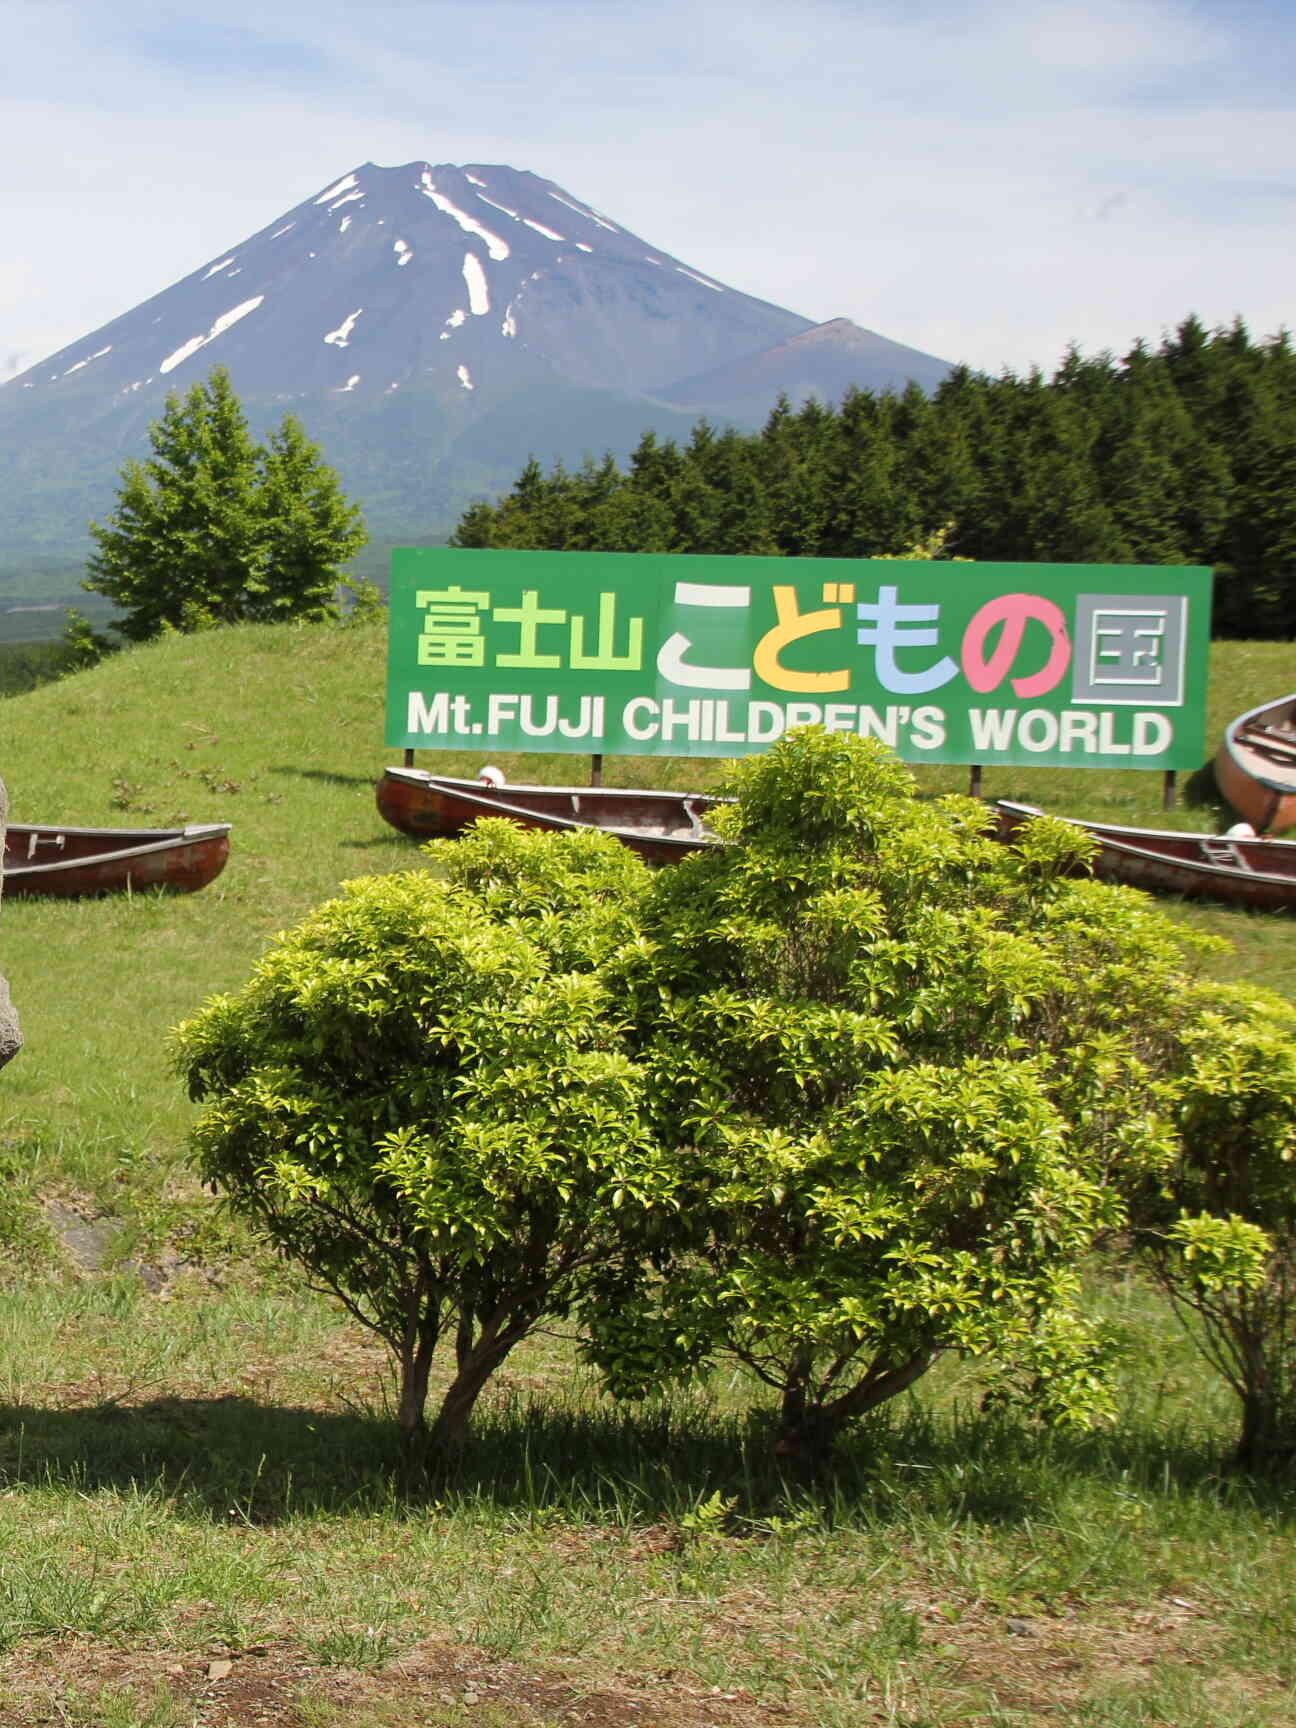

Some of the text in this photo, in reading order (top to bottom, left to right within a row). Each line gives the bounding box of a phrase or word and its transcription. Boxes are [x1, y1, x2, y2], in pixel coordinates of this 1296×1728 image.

[415, 582, 1188, 706] 富士山こどもの国
[407, 691, 604, 738] Mt.FUJI
[968, 708, 1174, 756] WORLD
